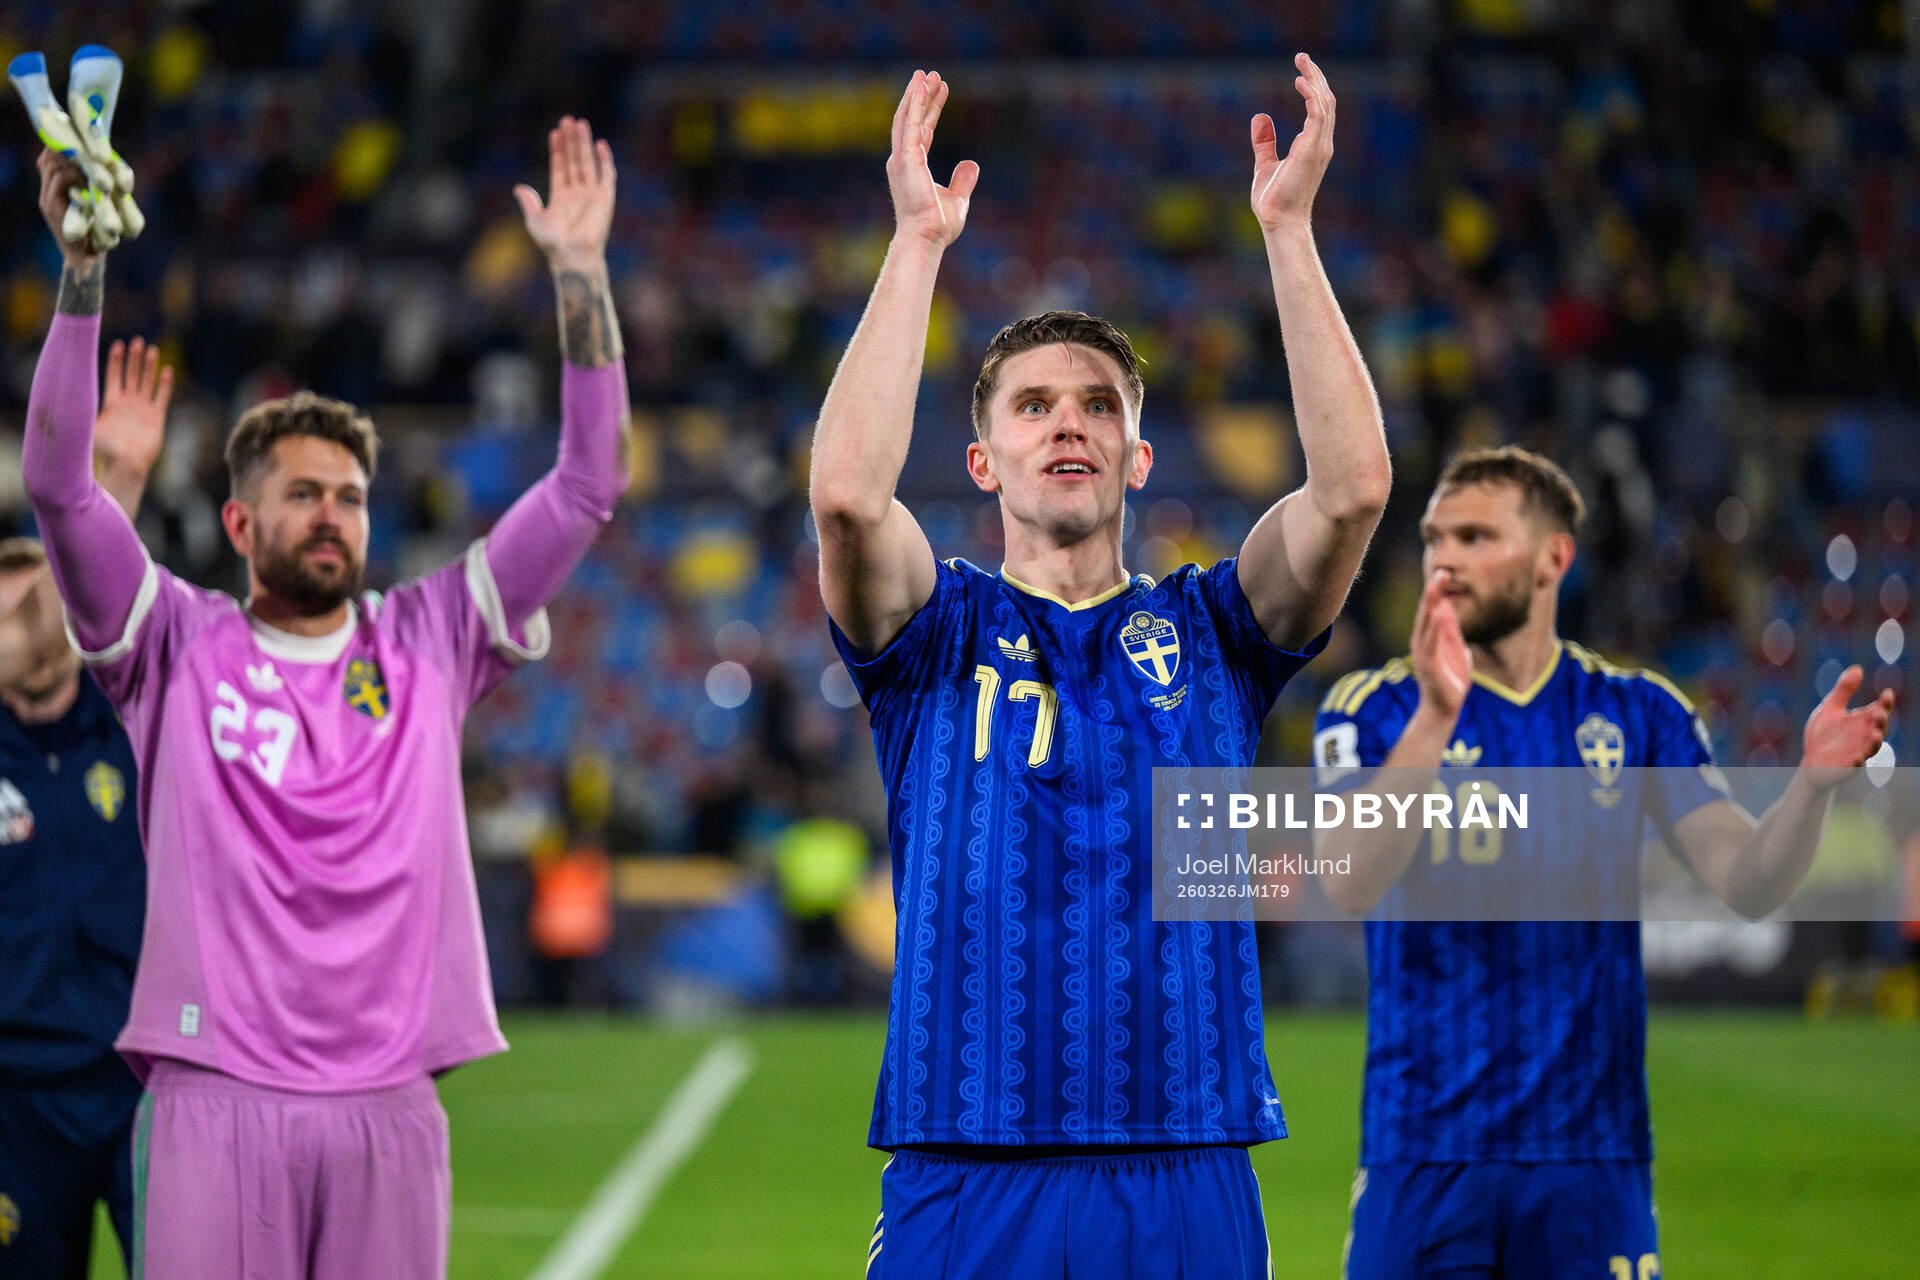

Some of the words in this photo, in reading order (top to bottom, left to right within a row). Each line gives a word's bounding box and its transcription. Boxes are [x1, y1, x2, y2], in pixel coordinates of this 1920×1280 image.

[1129, 628, 1168, 642] SVERIGE
[210, 679, 297, 788] 23
[974, 664, 1060, 769] 17
